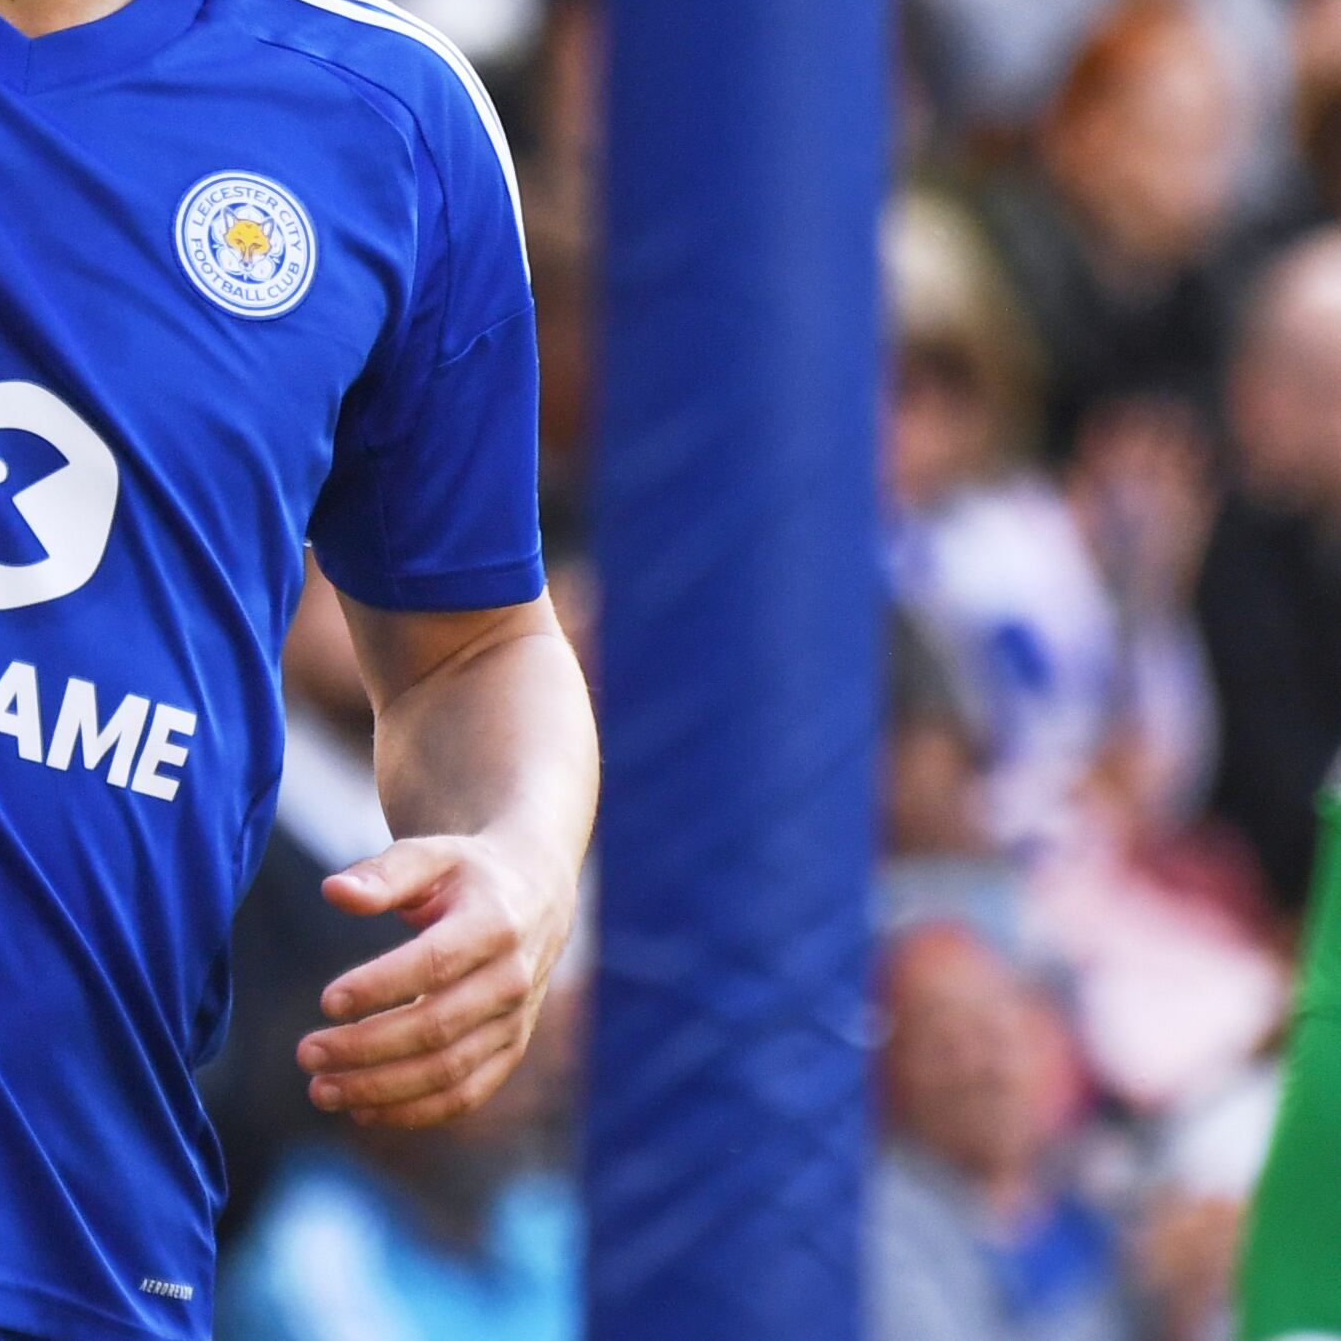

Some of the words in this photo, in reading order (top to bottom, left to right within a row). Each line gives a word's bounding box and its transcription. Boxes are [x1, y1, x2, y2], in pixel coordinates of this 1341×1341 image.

[193, 186, 278, 227] LEICESTER
[279, 209, 302, 251] CITY
[191, 237, 265, 301] FOOTBALL
[267, 261, 300, 299] CLUB
